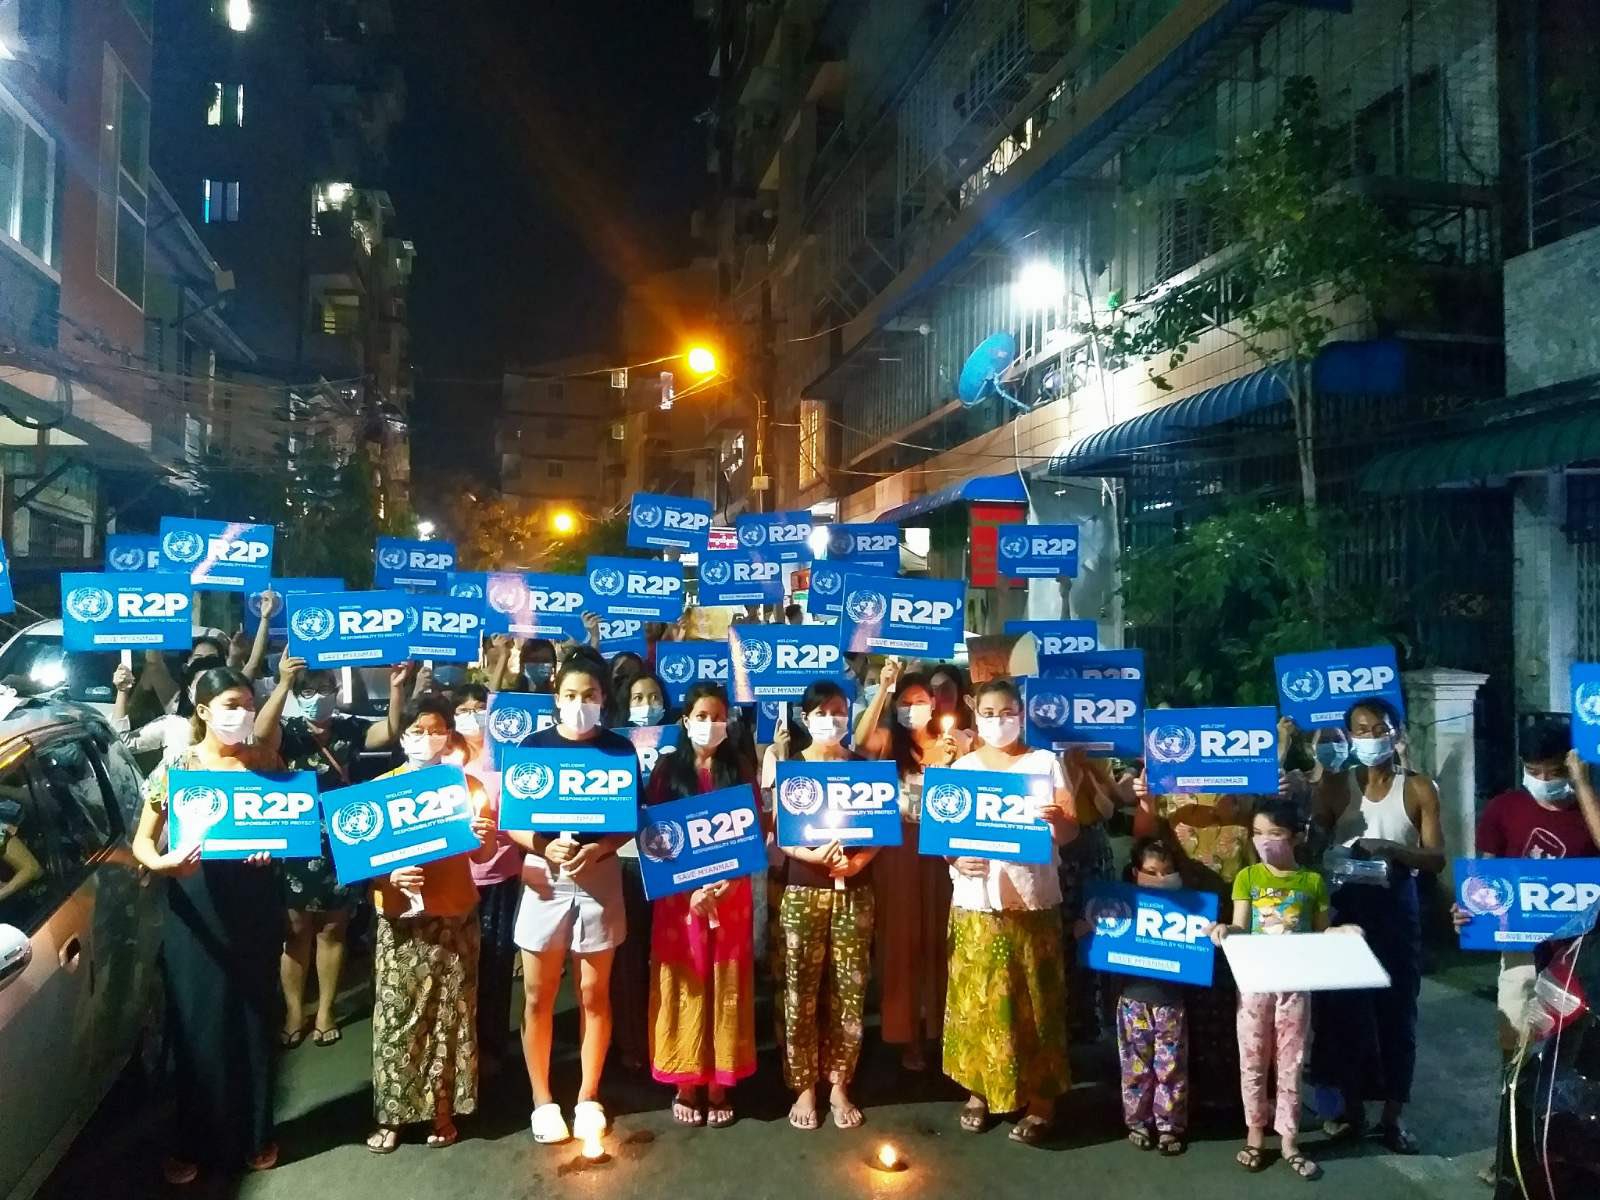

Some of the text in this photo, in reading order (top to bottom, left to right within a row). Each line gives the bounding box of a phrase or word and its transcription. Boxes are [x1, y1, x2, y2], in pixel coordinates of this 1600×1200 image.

[664, 510, 709, 530] R2P
[769, 524, 811, 542] R2P
[857, 535, 898, 551] R2P
[207, 538, 269, 563] R2P
[1032, 539, 1076, 555] R2P
[410, 552, 453, 569] R2P
[734, 562, 780, 581] R2P
[628, 575, 681, 596] R2P
[118, 593, 189, 617] R2P
[529, 591, 584, 612] R2P
[890, 599, 953, 625] R2P
[339, 609, 404, 635] R2P
[422, 611, 478, 634] R2P
[598, 620, 641, 640] R2P
[776, 645, 839, 669] R2P
[1044, 637, 1095, 655] R2P
[1328, 666, 1394, 694] R2P
[1074, 699, 1136, 724] R2P
[1201, 730, 1274, 757] R2P
[385, 789, 414, 799] WELCOME
[559, 769, 633, 795] R2P
[234, 792, 314, 819] R2P
[387, 784, 466, 830] R2P
[827, 782, 895, 809] R2P
[687, 808, 754, 848] R2P
[1520, 883, 1600, 911] R2P
[1136, 908, 1210, 944] R2P
